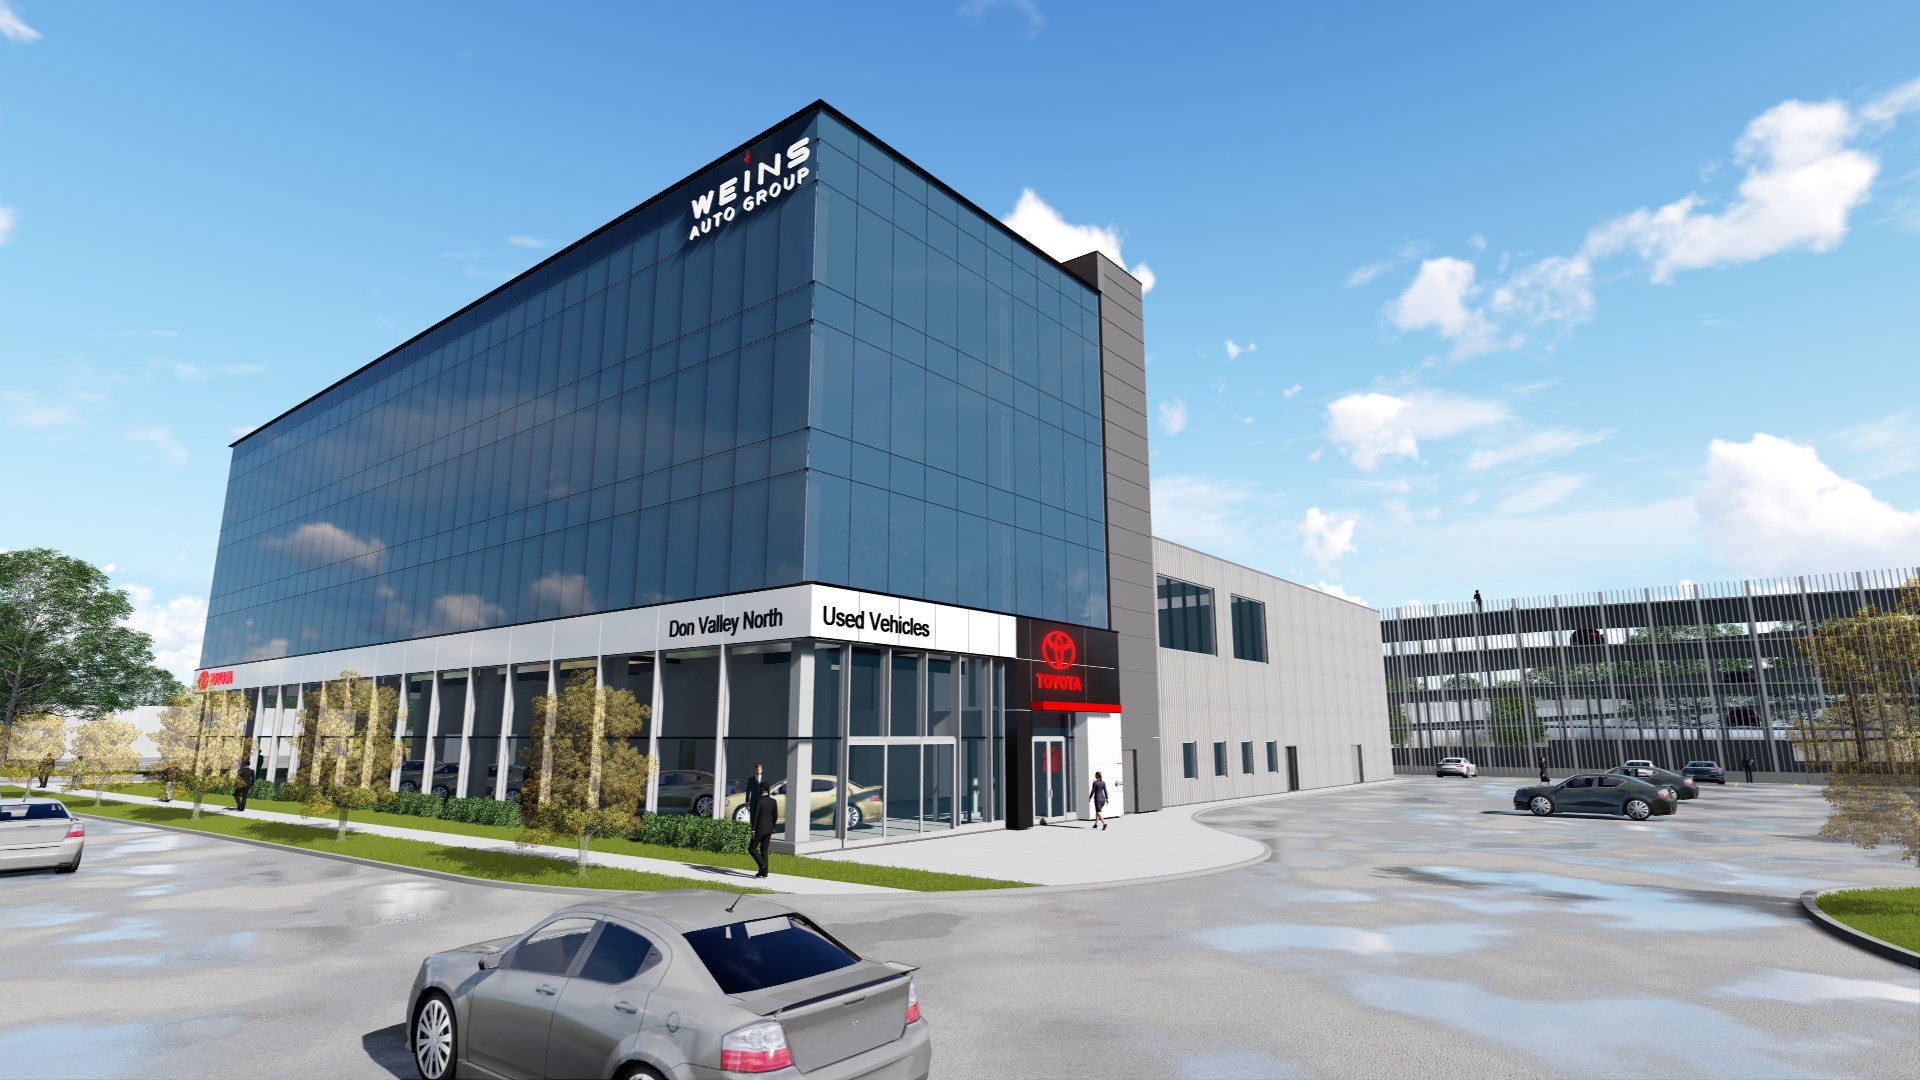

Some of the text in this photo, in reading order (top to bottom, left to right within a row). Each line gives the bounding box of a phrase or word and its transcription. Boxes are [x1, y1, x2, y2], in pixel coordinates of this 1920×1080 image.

[689, 166, 810, 241] AUTO GROUP
[668, 607, 783, 638] Don Valley North
[823, 605, 931, 638] Used Vehicles
[1036, 673, 1083, 692] TOYOTA
